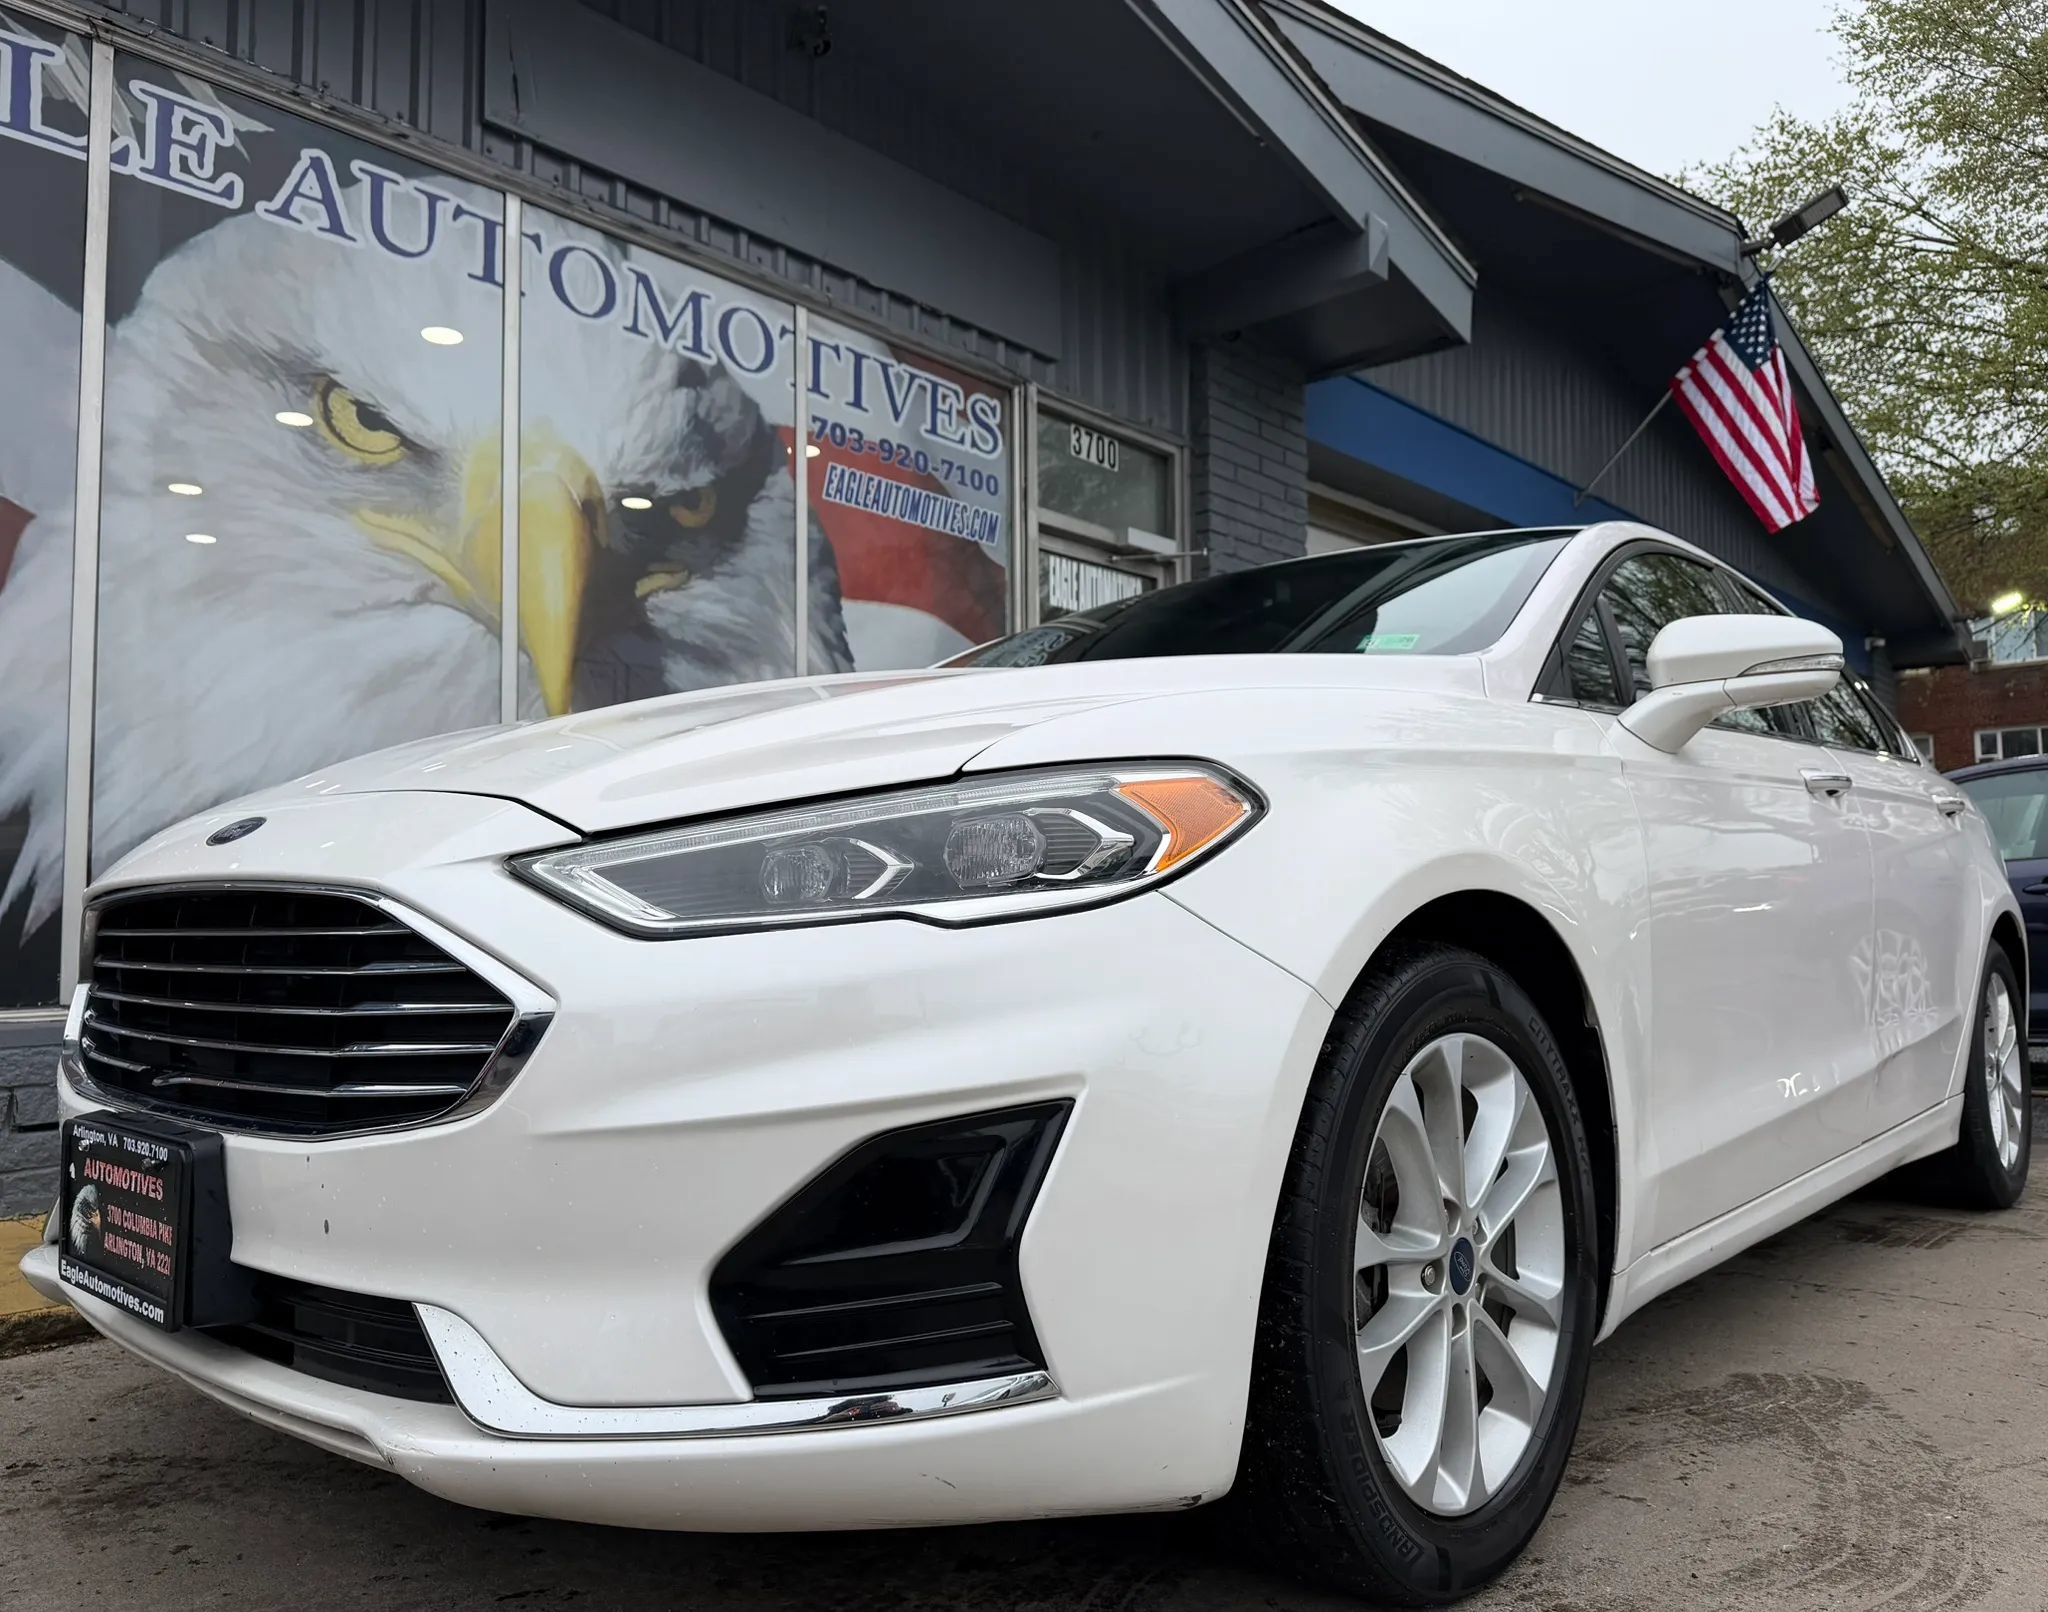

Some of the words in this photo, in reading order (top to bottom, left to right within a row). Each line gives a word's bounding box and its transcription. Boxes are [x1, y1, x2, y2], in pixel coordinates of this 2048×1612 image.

[259, 155, 1001, 455] AUTOMOTIVES
[811, 414, 1000, 496] 703-920-7100
[1072, 425, 1117, 469] 3700
[823, 464, 1000, 545] EAGLEAUTOMOTIVES.COM
[73, 1125, 107, 1147] Arlington,
[107, 1132, 118, 1148] VA
[123, 1137, 168, 1162] 703.920.7100
[84, 1157, 164, 1200] AUTOMOTIVES
[107, 1204, 121, 1227] 3700
[122, 1209, 157, 1239] COLUMBIA
[103, 1231, 145, 1268] ARLINGTON,
[145, 1246, 156, 1269] VA
[61, 1259, 165, 1324] EagleAutomotives.com
